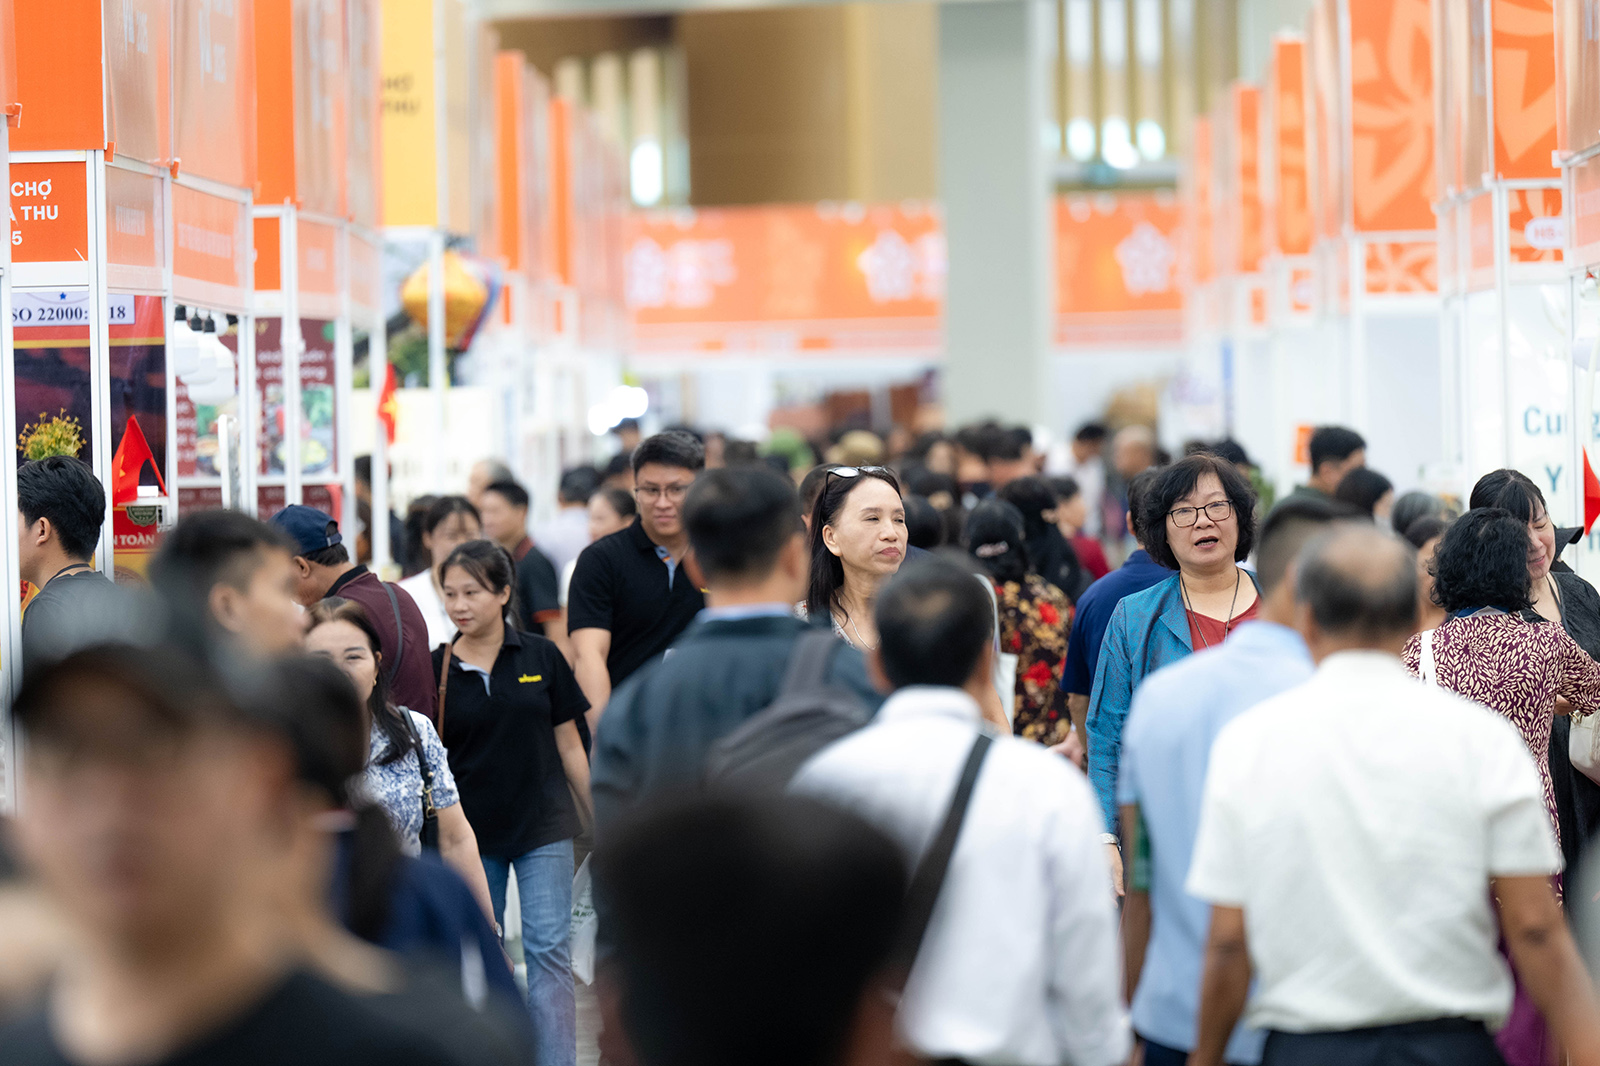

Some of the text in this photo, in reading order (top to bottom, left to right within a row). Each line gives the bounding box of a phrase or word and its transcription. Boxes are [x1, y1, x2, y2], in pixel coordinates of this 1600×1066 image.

[11, 179, 52, 200] CHỢ
[20, 205, 59, 221] THU
[38, 305, 126, 322] 22000:18
[121, 532, 155, 546] TOÀN
